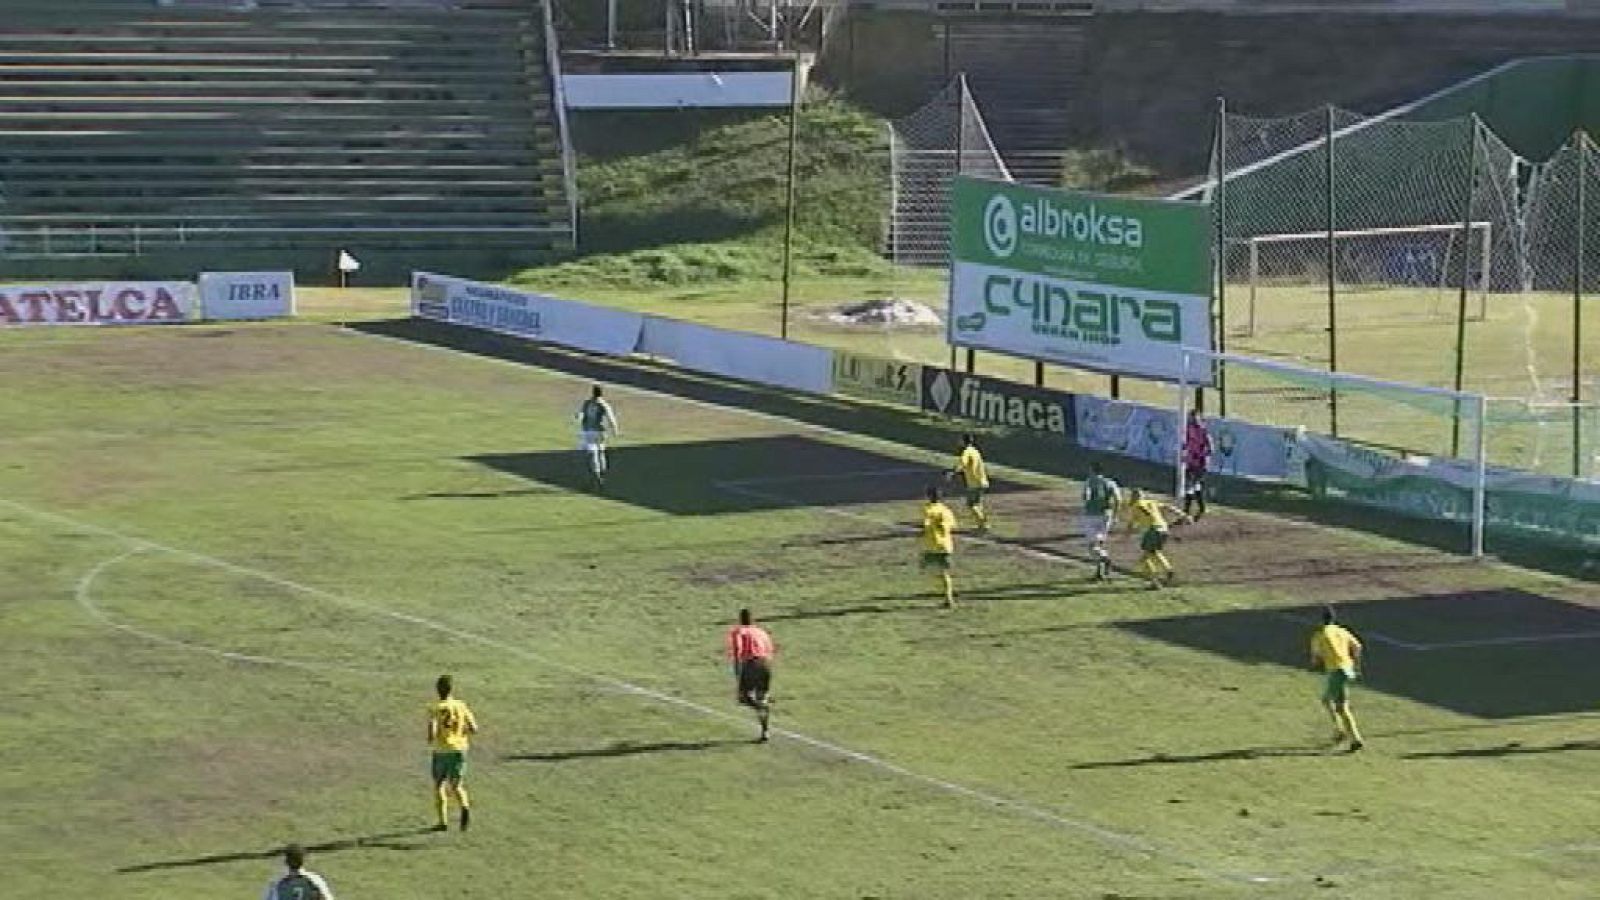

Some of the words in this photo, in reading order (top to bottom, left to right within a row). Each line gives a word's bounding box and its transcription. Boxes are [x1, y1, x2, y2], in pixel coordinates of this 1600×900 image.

[1020, 199, 1143, 248] albroksa
[0, 287, 185, 323] ATELCA
[228, 283, 280, 301] IBRA
[984, 274, 1182, 342] cynara
[960, 377, 1066, 433] fimaca
